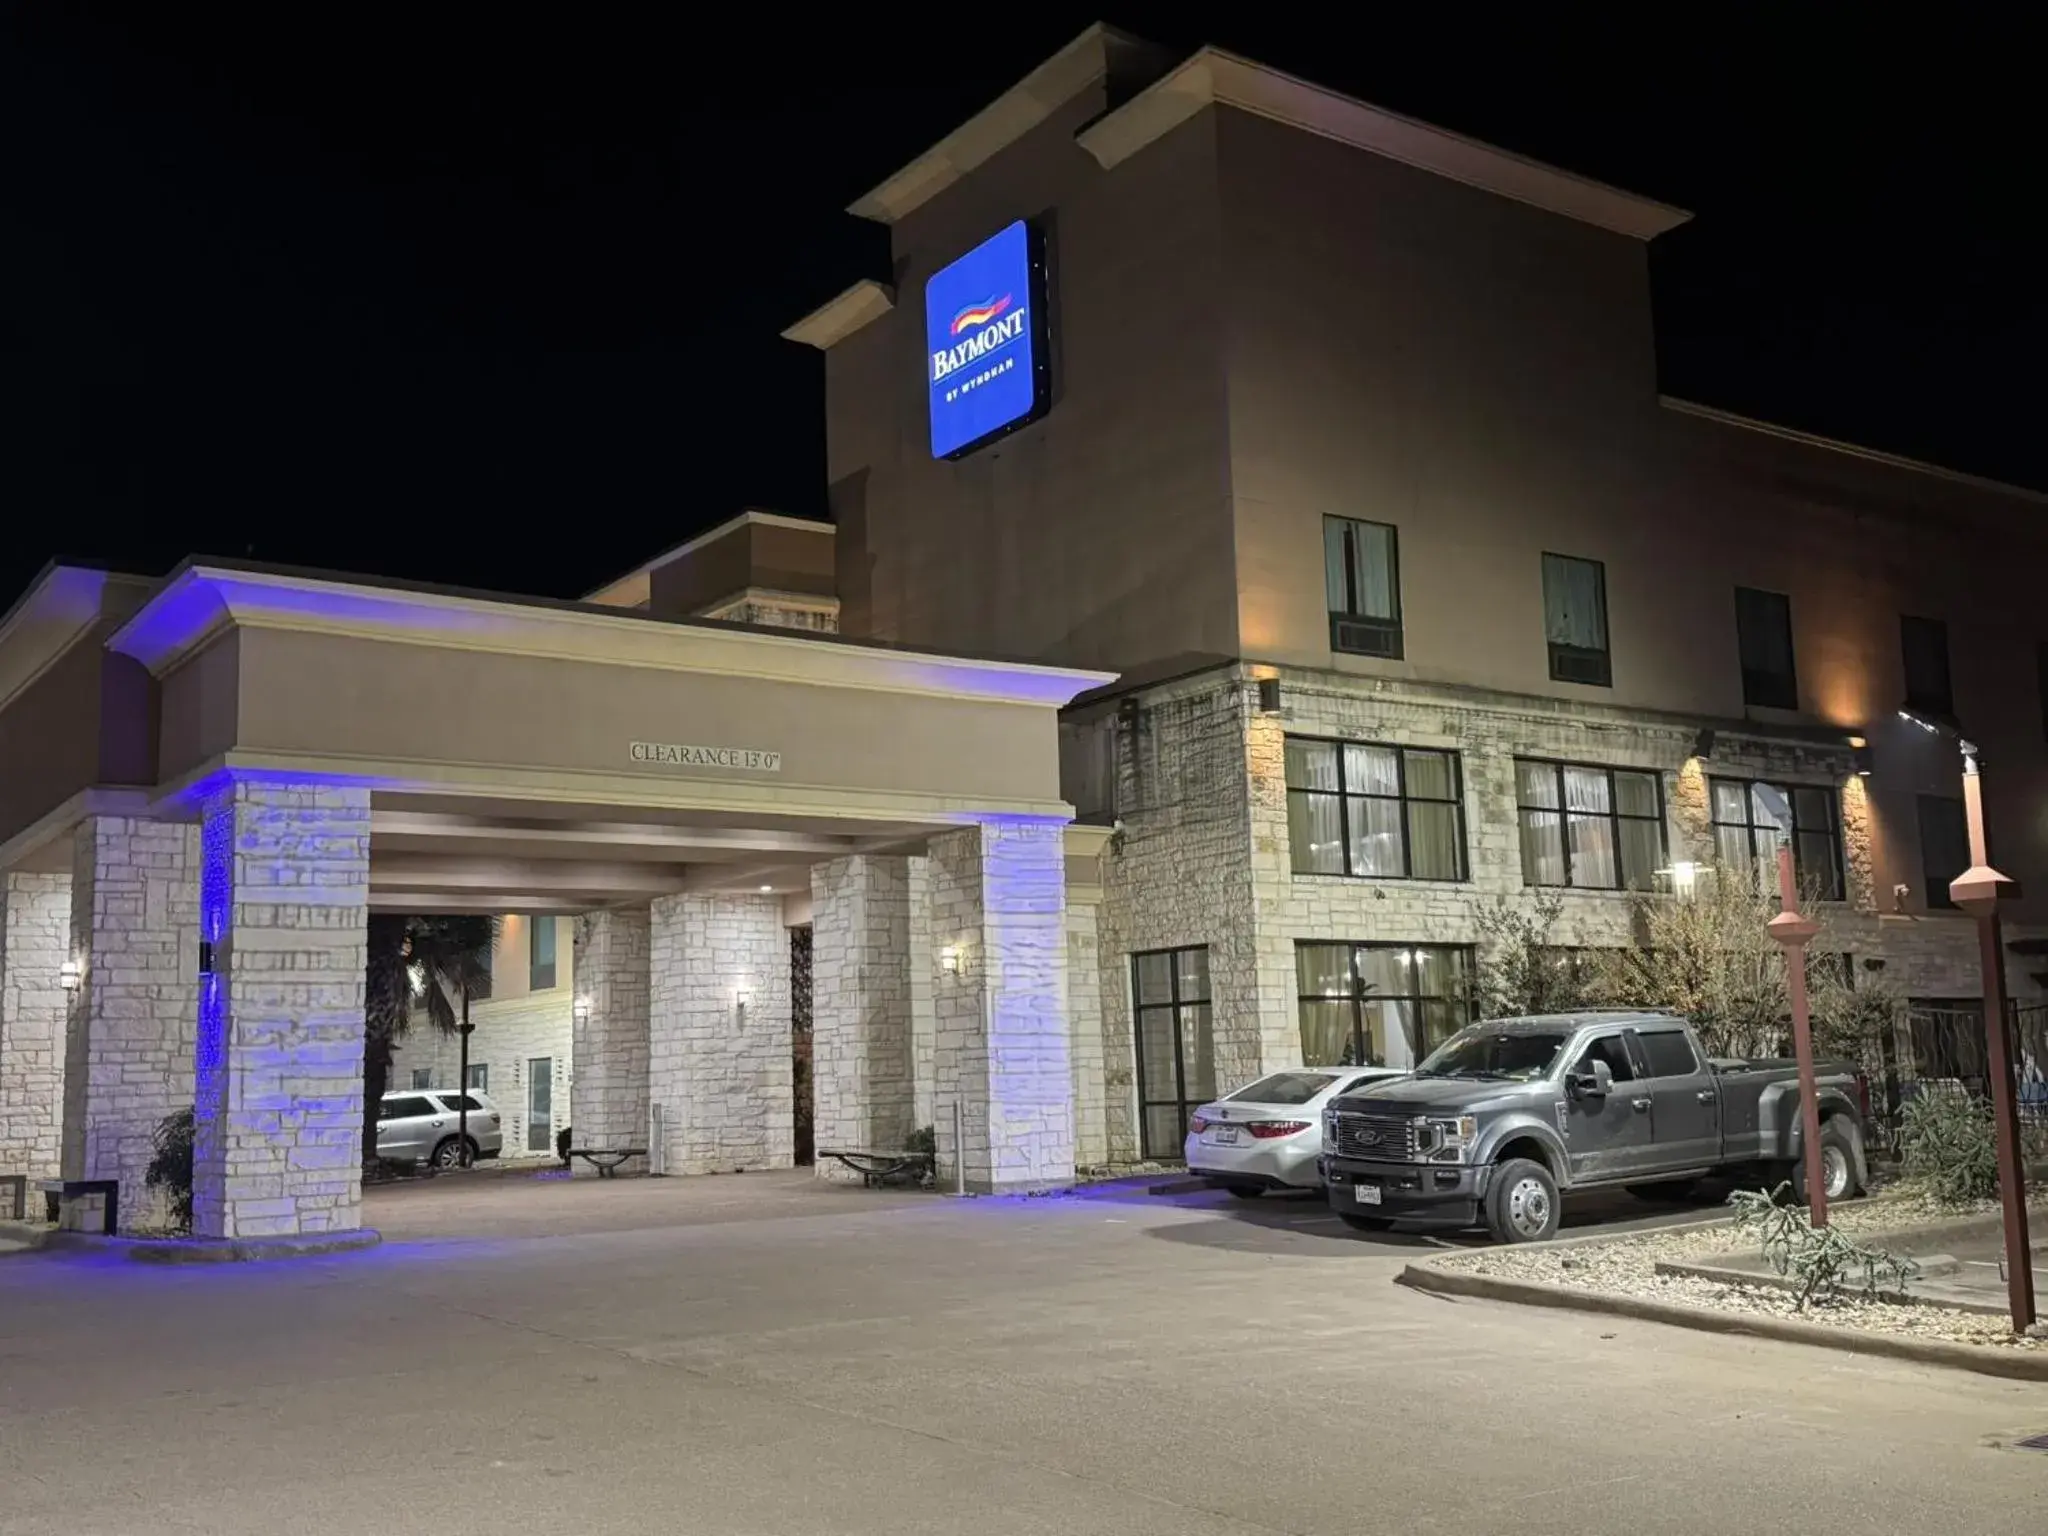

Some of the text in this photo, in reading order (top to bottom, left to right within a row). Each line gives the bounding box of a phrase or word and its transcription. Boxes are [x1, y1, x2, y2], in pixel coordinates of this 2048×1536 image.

[932, 308, 1025, 381] BAYMONT
[946, 357, 1014, 402] BY WYNDHAM
[631, 743, 739, 766] CLEARANCE
